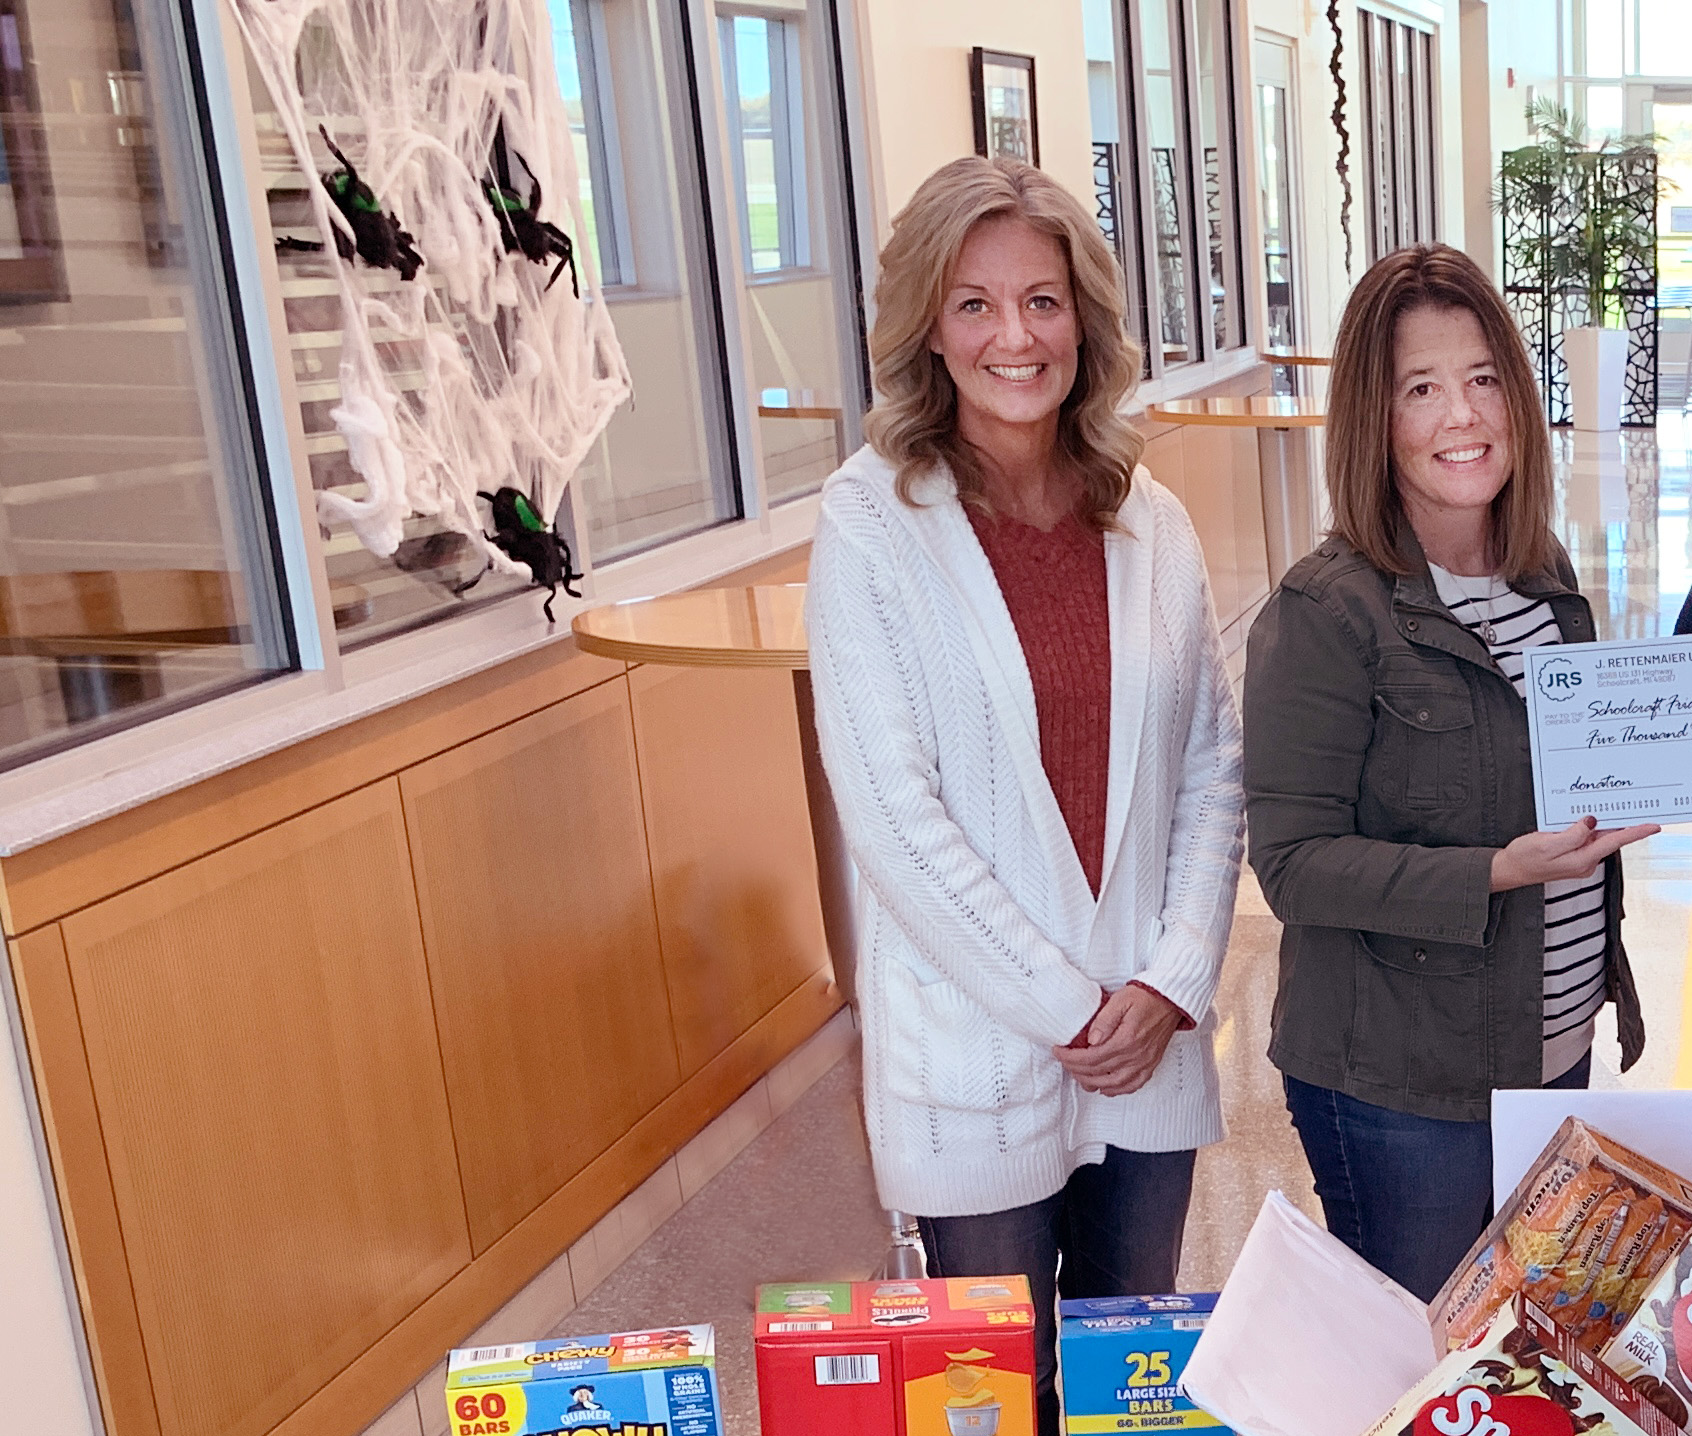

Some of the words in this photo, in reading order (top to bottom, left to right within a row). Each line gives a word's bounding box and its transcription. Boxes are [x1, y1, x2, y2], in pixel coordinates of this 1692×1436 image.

[1595, 659, 1605, 669] J.
[1608, 653, 1686, 668] RETTENMAIER
[1547, 671, 1583, 689] JRS
[1588, 698, 1666, 720] Schoolcraft
[1586, 729, 1616, 749] Five
[1620, 723, 1689, 743] Thousand
[1569, 775, 1633, 792] donation
[1124, 1352, 1171, 1386] 25
[1116, 1388, 1155, 1401] LARGE
[455, 1393, 507, 1420] 60
[1128, 1399, 1173, 1414] BARS
[560, 1409, 612, 1425] QUAKER
[458, 1420, 510, 1436] BARS
